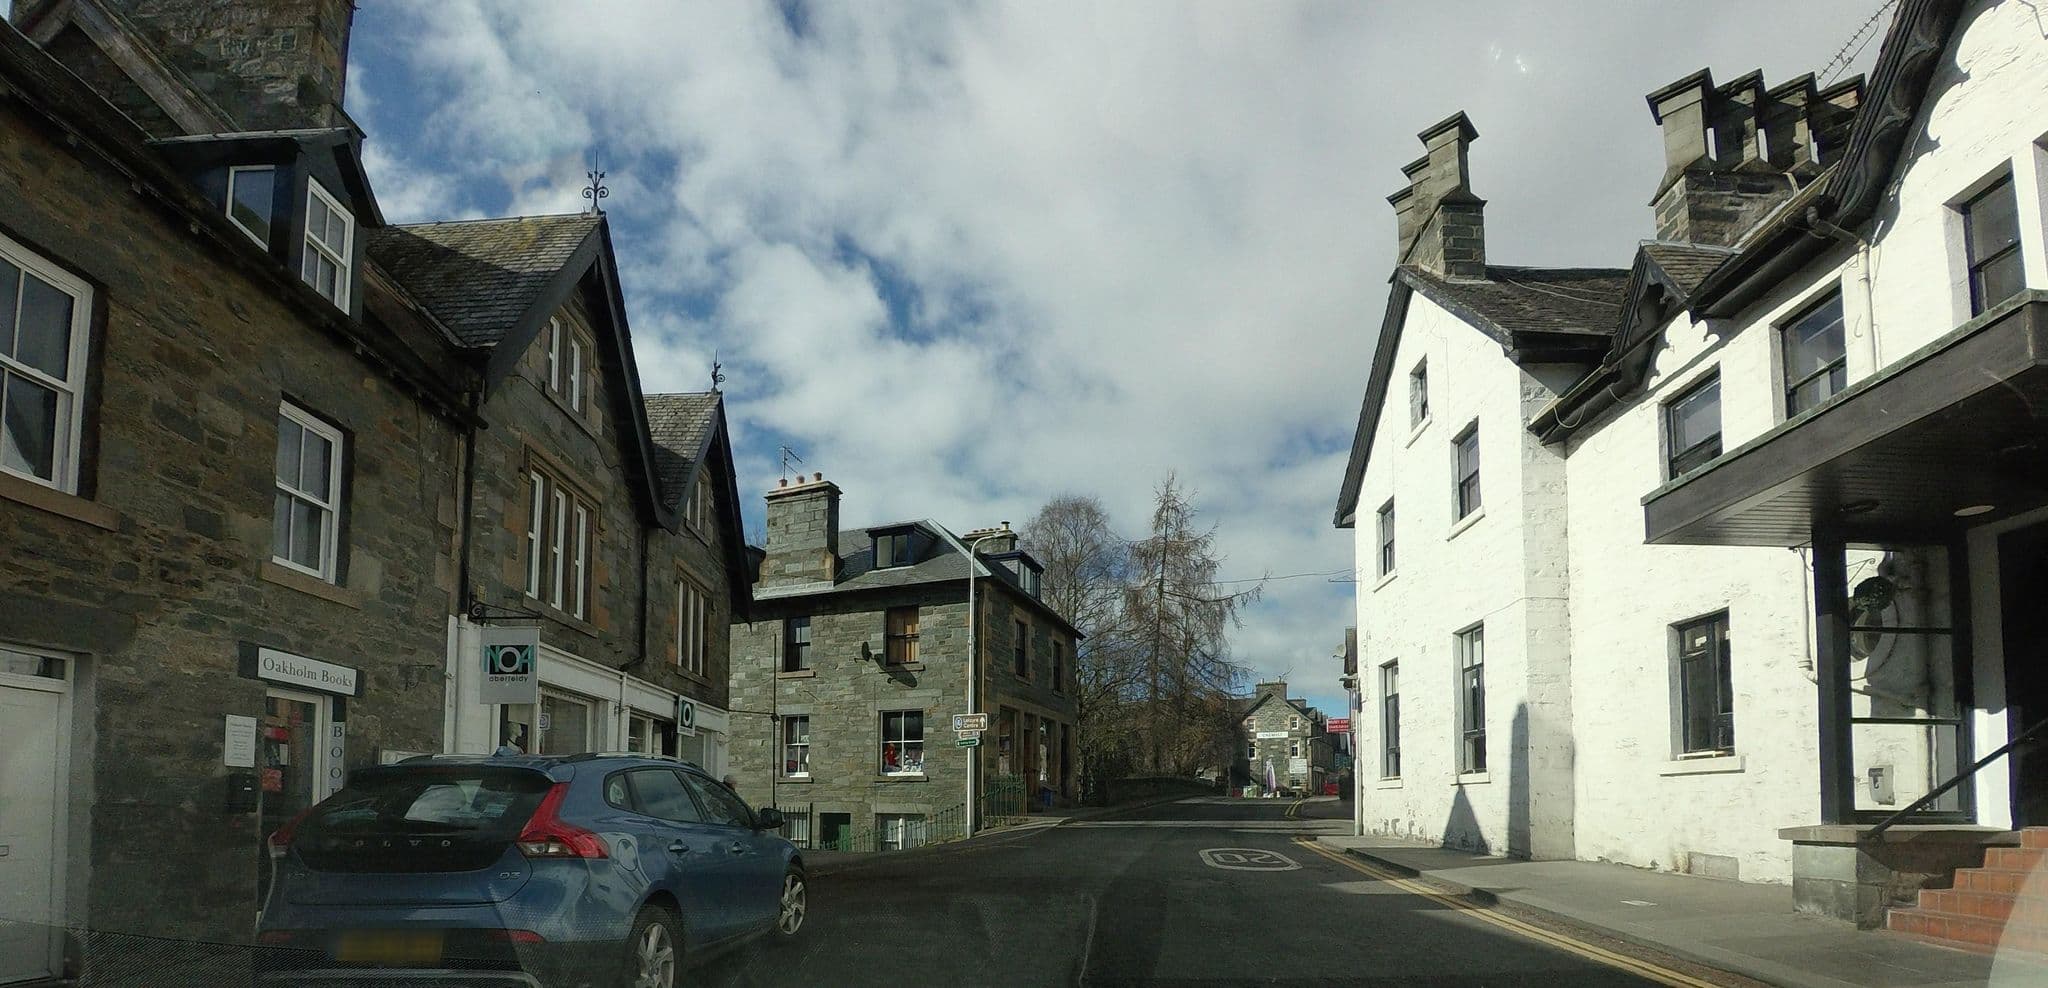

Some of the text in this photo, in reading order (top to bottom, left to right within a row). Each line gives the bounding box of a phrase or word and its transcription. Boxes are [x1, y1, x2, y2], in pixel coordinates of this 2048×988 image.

[483, 644, 536, 672] NOA
[263, 657, 353, 688] Oakholm Books
[489, 675, 529, 683] aberfeldy
[331, 726, 343, 793] BOO
[328, 838, 451, 848] OLVO
